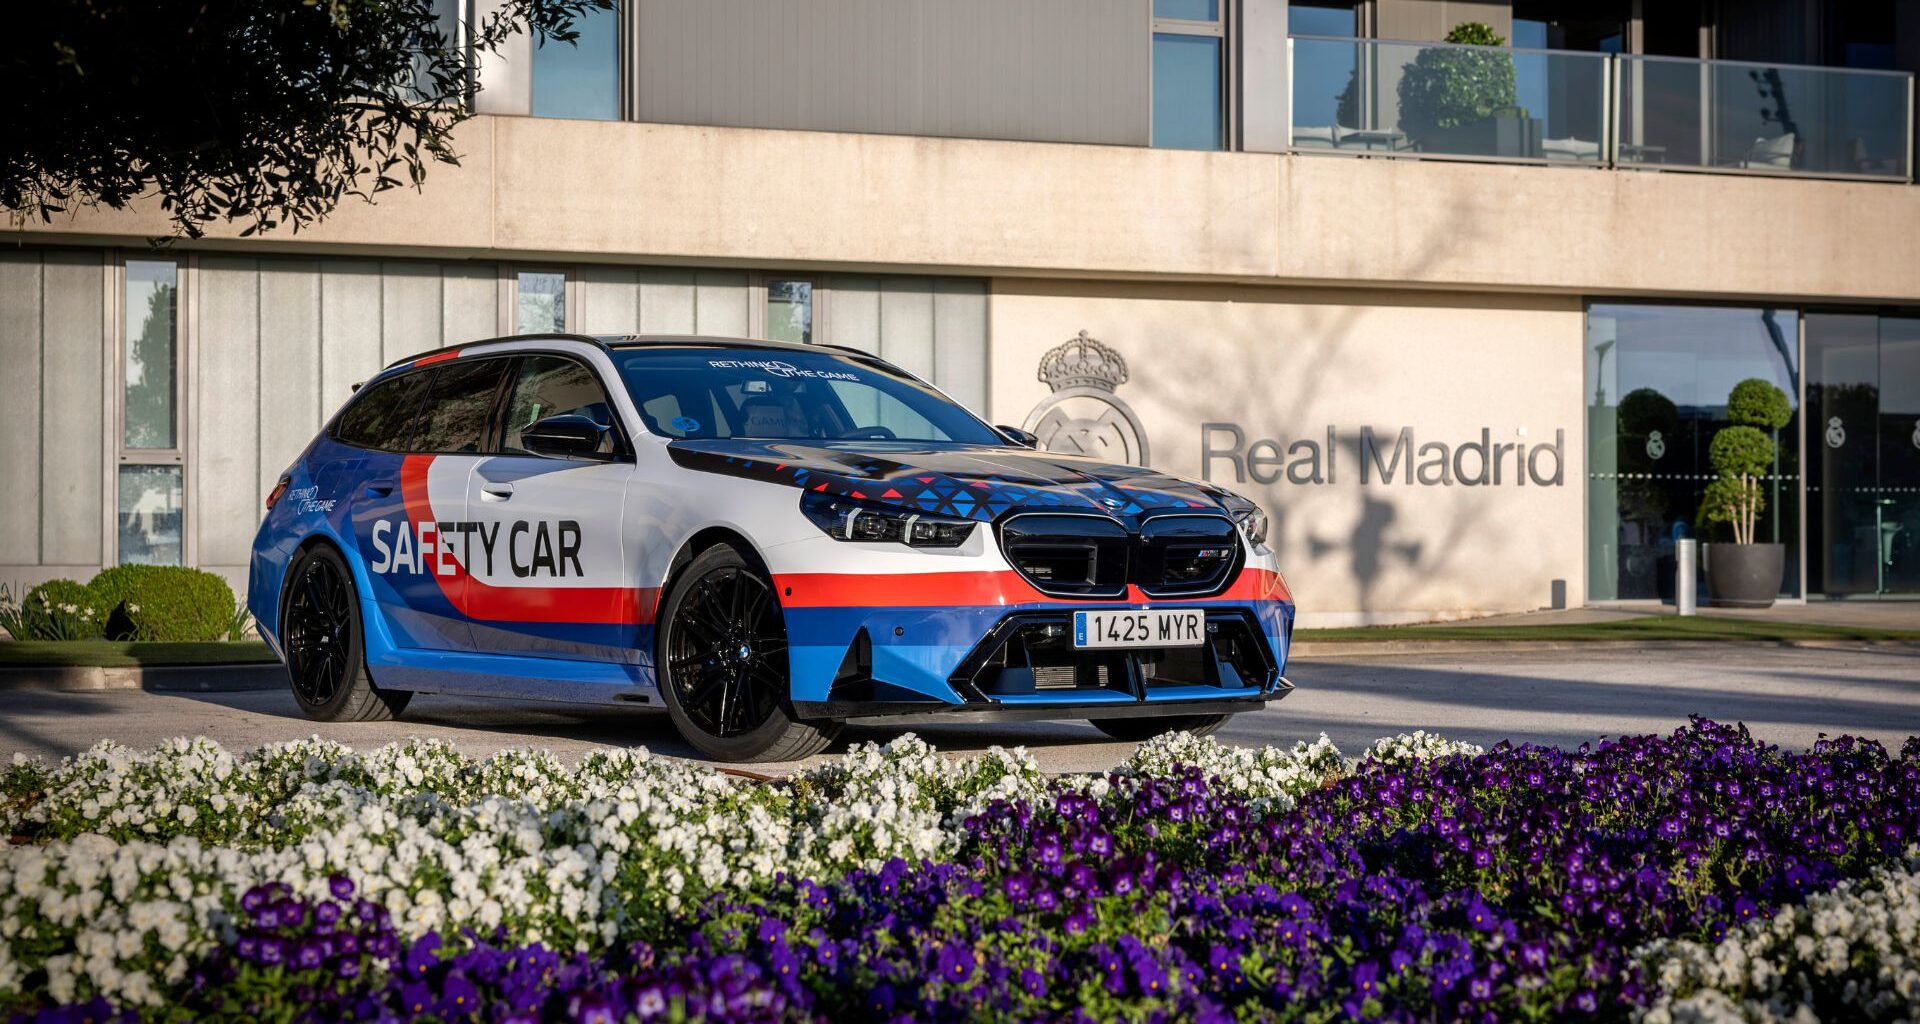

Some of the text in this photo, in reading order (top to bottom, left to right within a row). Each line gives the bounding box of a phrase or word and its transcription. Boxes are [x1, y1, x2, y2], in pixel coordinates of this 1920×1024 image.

[708, 360, 860, 381] RETHINK THE GAME
[1201, 422, 1565, 487] Real Madrid
[314, 500, 336, 512] GAME
[371, 519, 585, 578] SAFETY CAR
[1094, 614, 1199, 642] 1425 MYR
